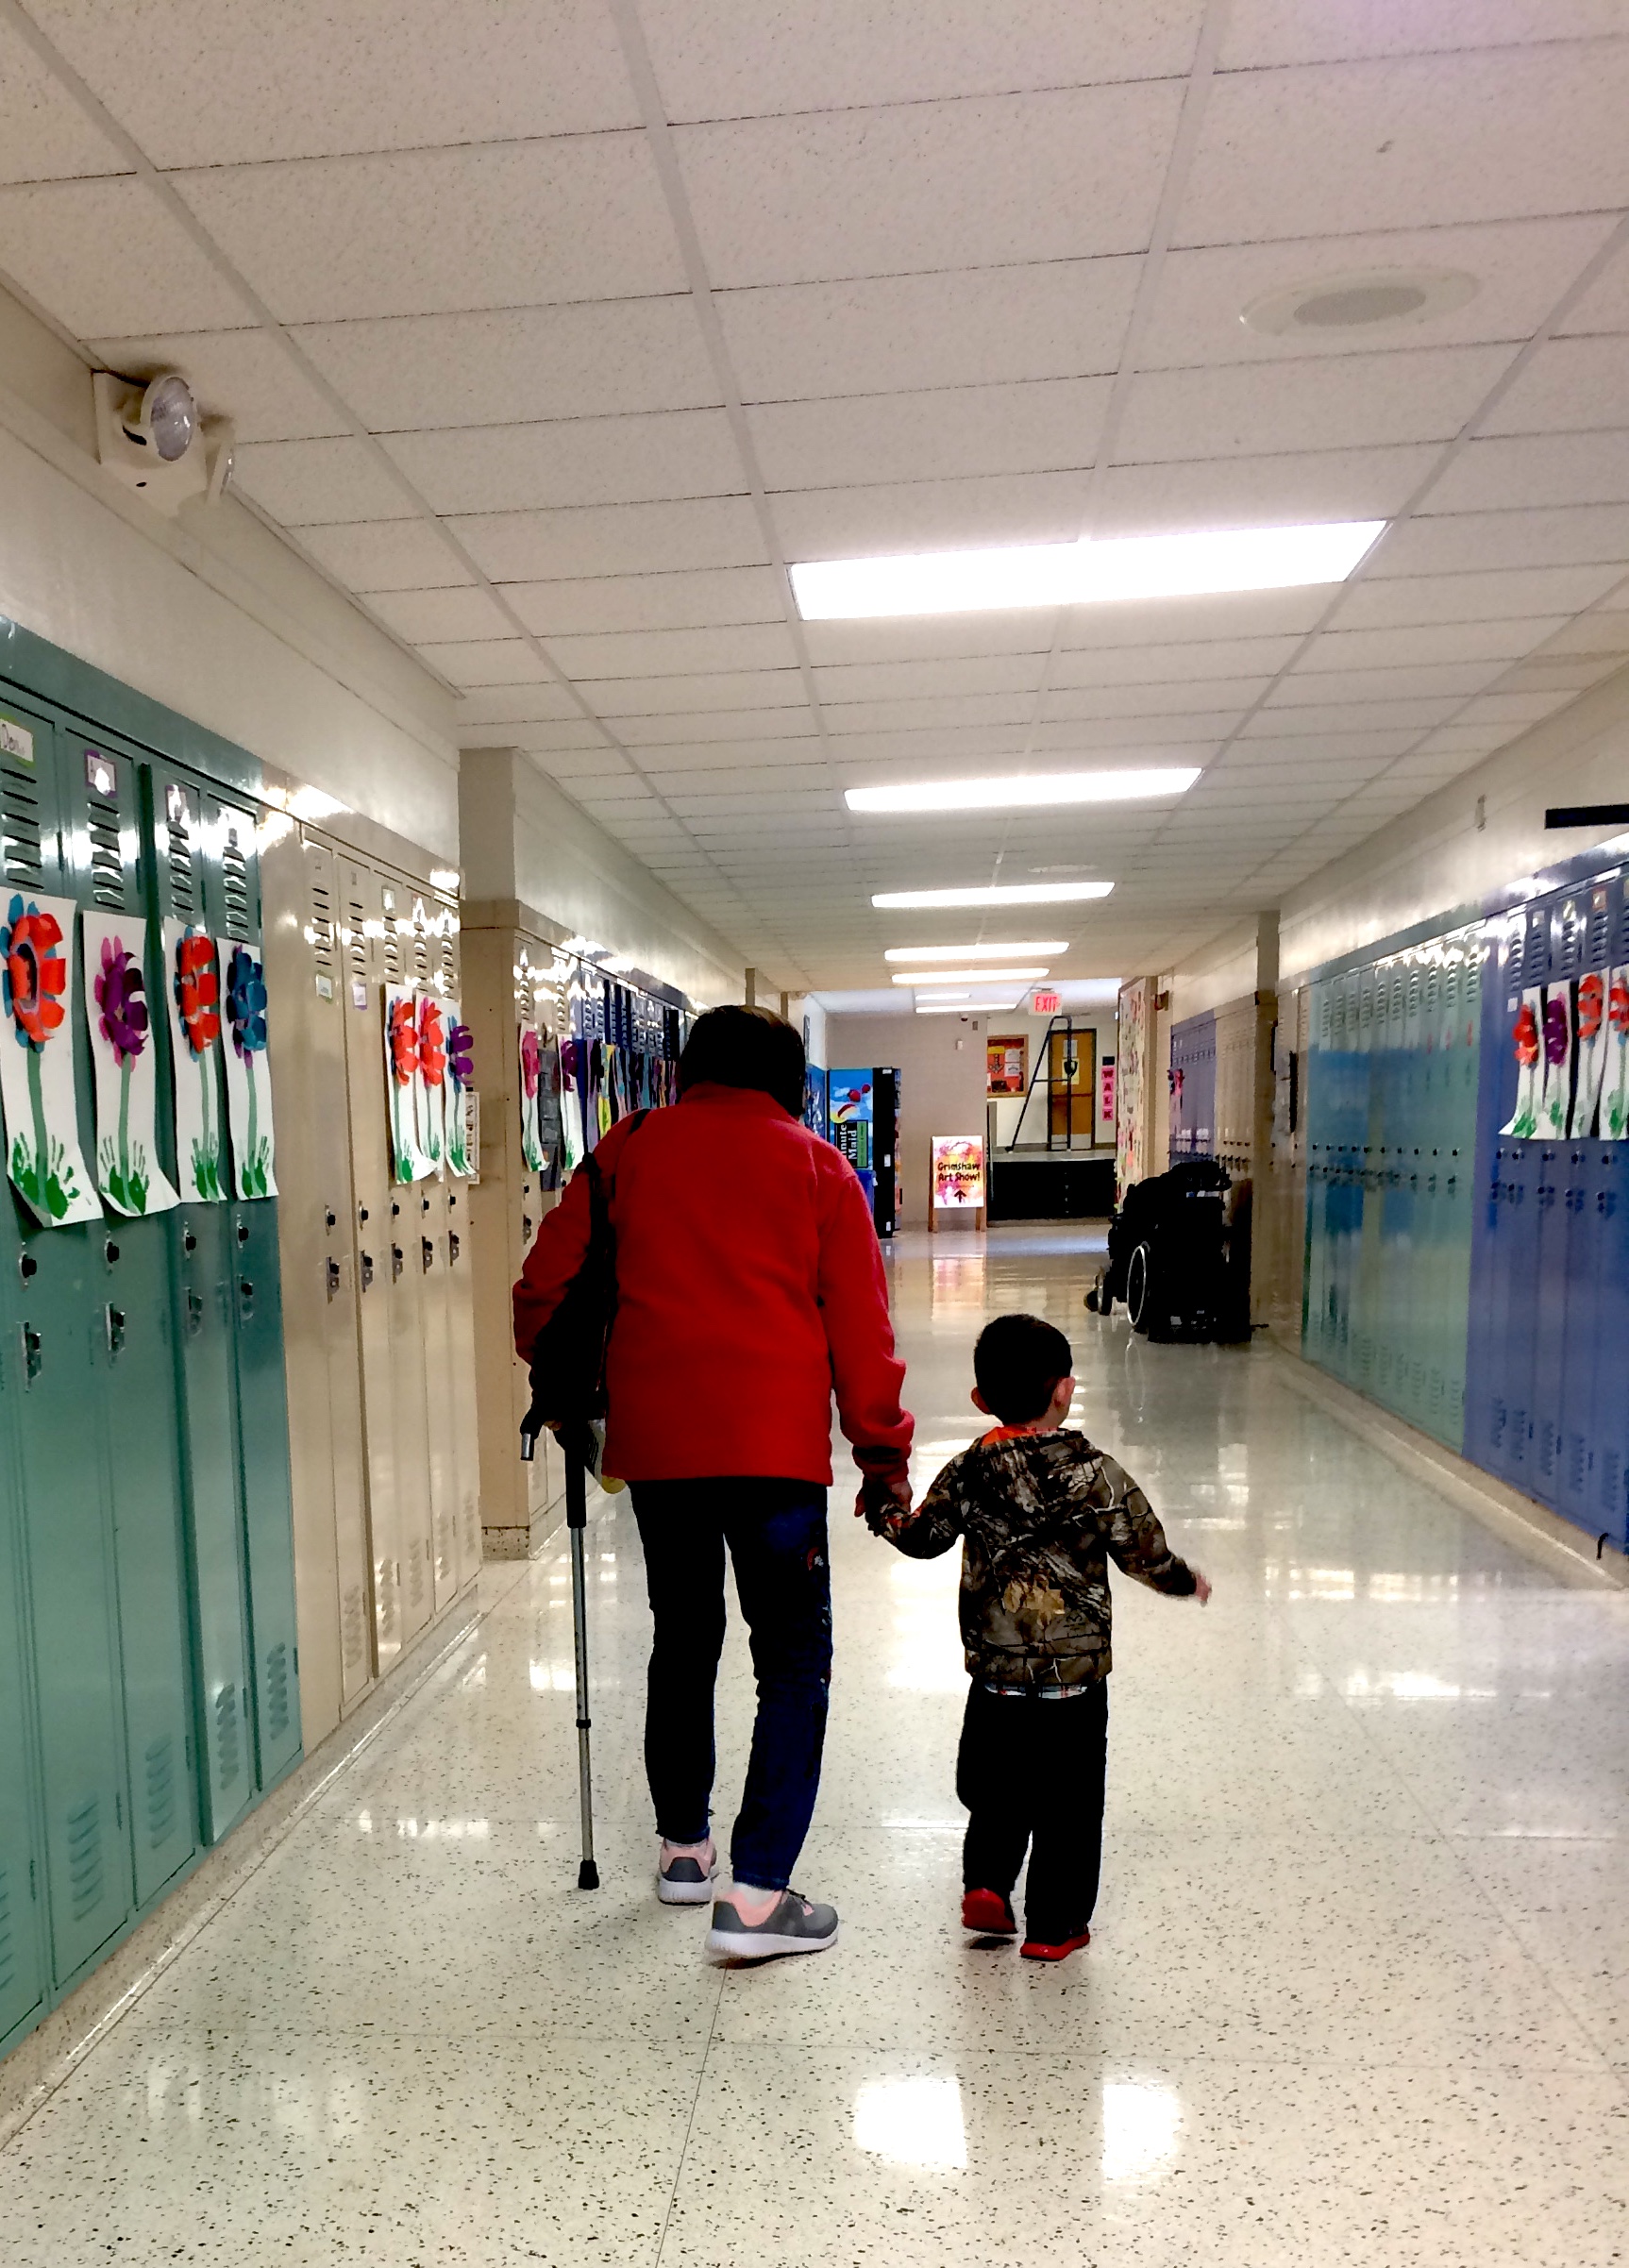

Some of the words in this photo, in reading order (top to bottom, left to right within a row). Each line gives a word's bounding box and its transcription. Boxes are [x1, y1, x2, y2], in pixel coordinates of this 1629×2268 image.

[1035, 996, 1057, 1013] EXIT
[1102, 1069, 1114, 1118] WALK
[848, 1130, 857, 1160] Maid
[937, 1161, 981, 1171] Grimshaw
[938, 1172, 953, 1183] Art
[954, 1171, 981, 1182] Show!
